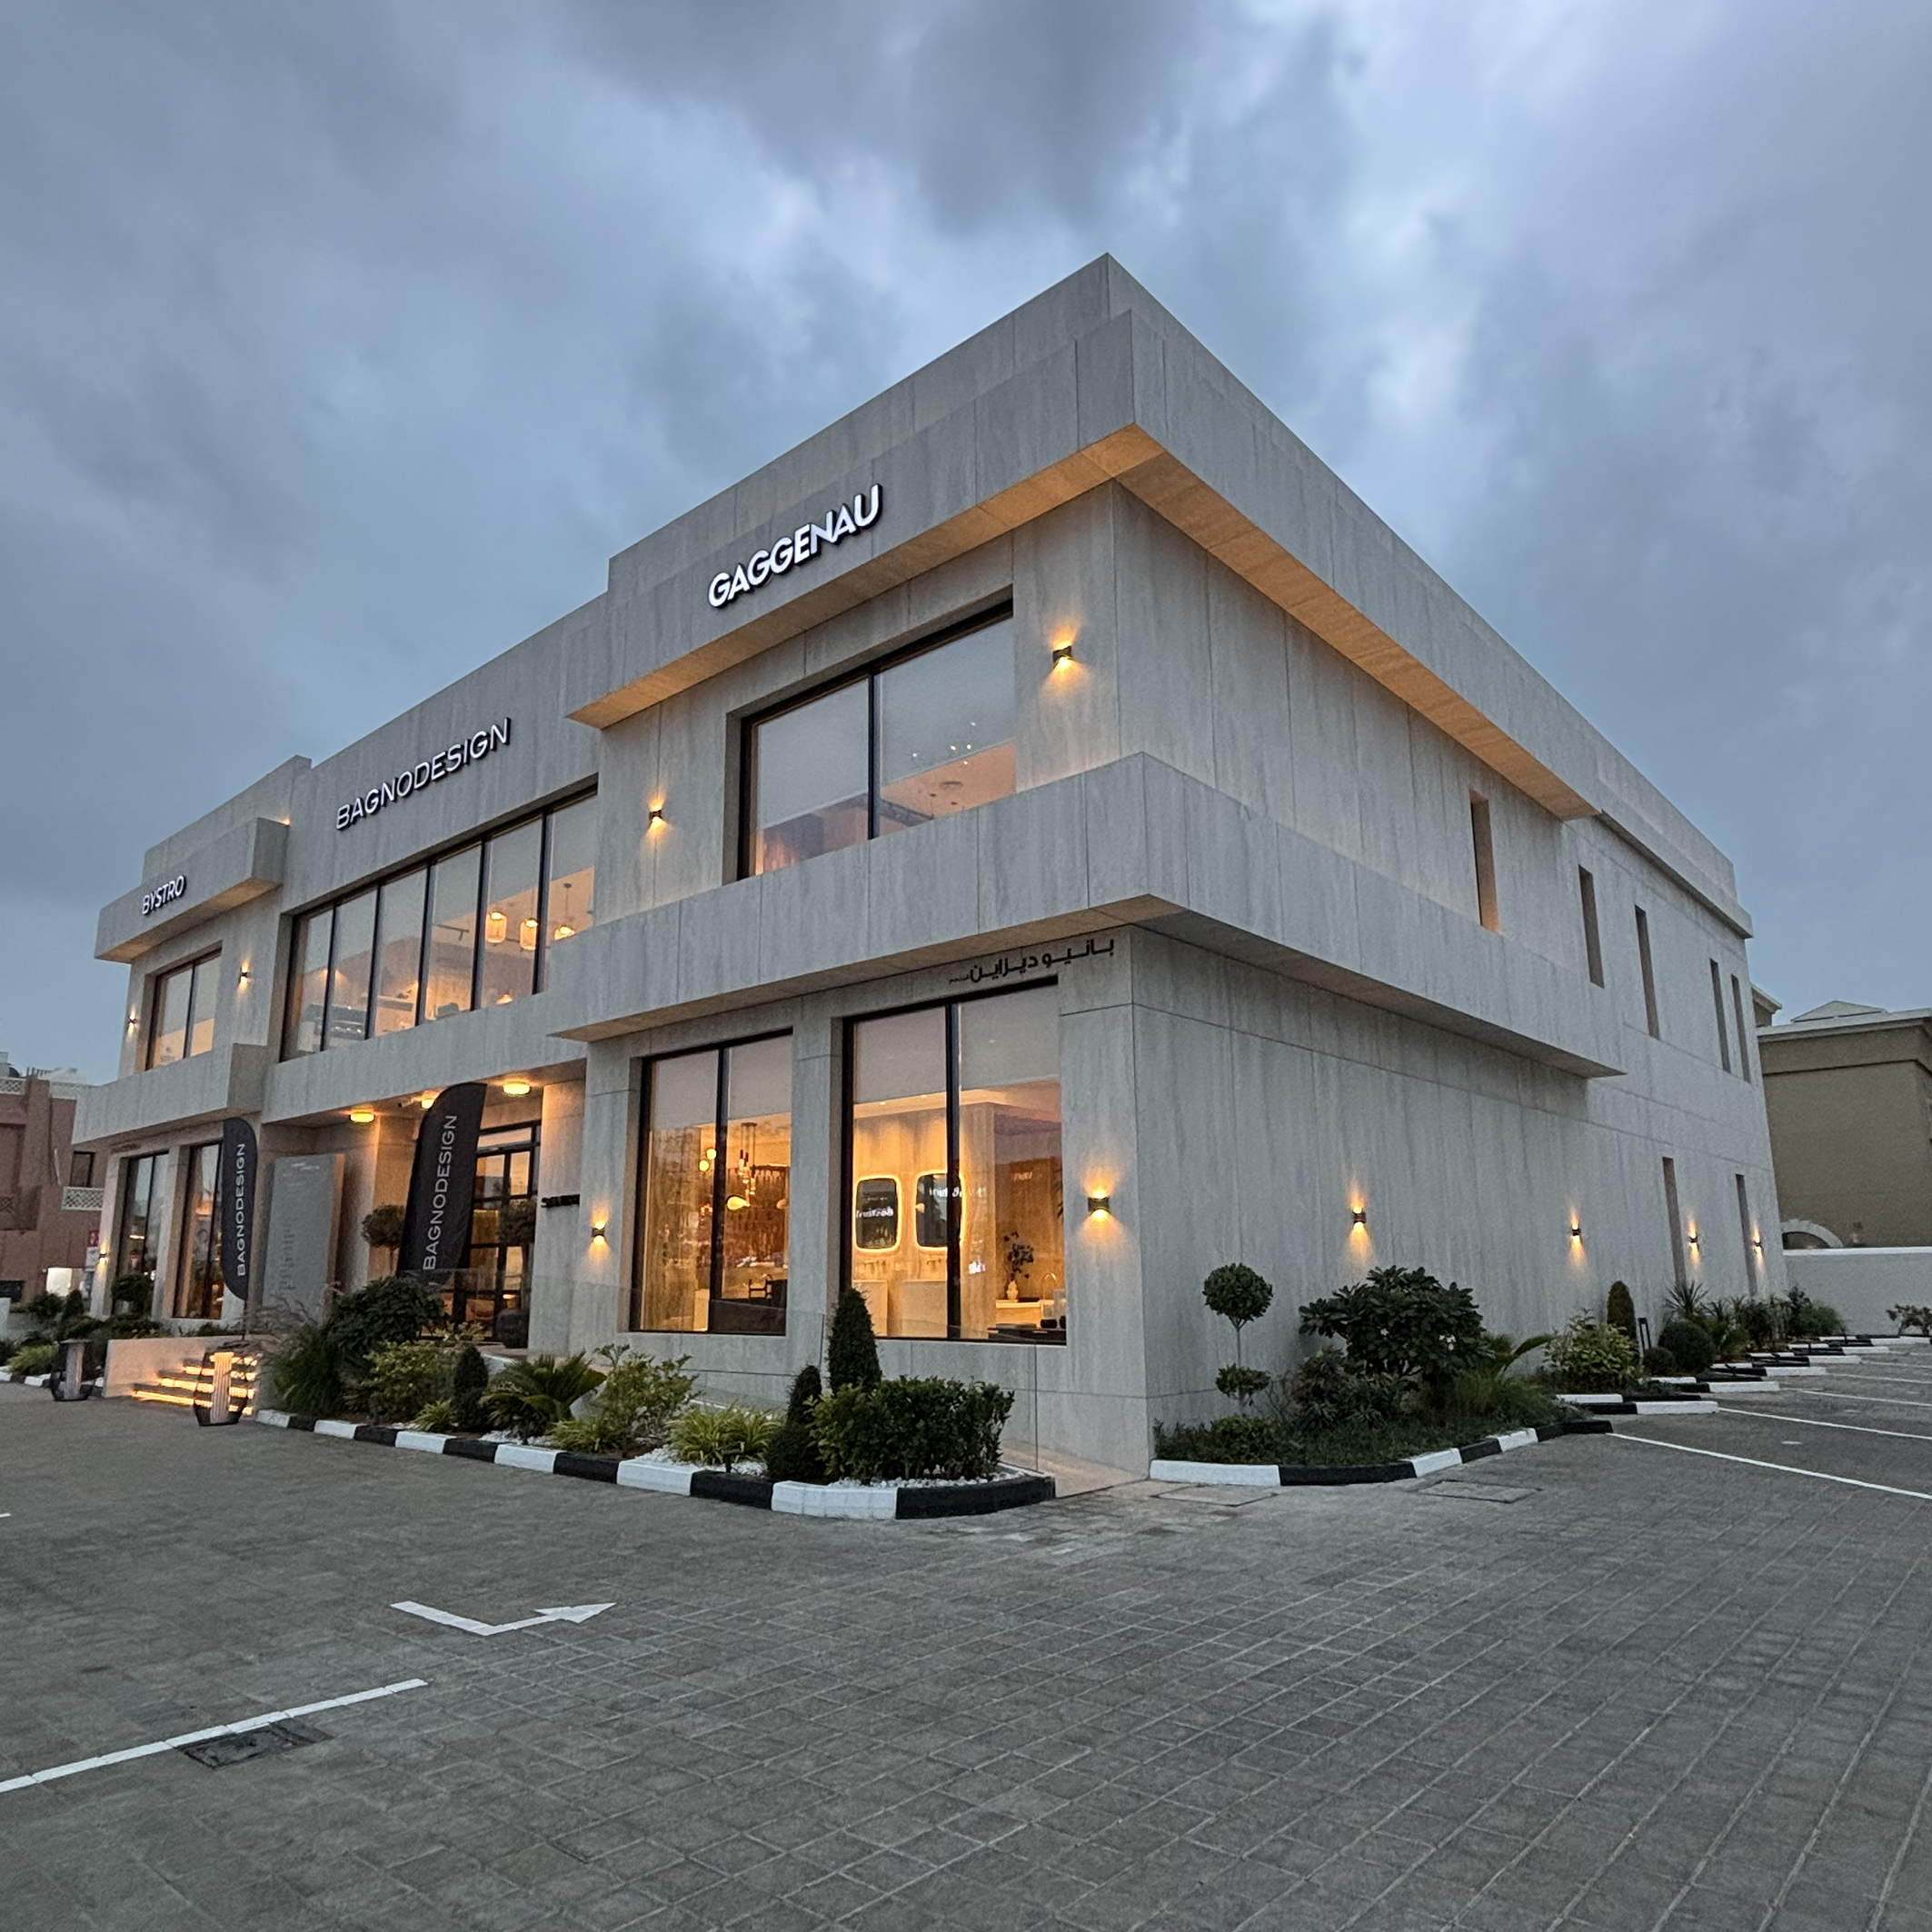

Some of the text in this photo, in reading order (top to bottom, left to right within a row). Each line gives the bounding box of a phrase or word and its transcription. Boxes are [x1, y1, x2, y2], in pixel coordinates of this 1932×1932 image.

[708, 483, 882, 608] GAGGENAU
[336, 717, 511, 830] BAGNODESIGN
[142, 875, 186, 915] BYSTRO
[970, 957, 1039, 983] ديزاين
[1042, 939, 1114, 968] بانيو
[235, 1142, 245, 1277] BAGNODESIGN
[423, 1115, 457, 1270] BAGNODESIGN
